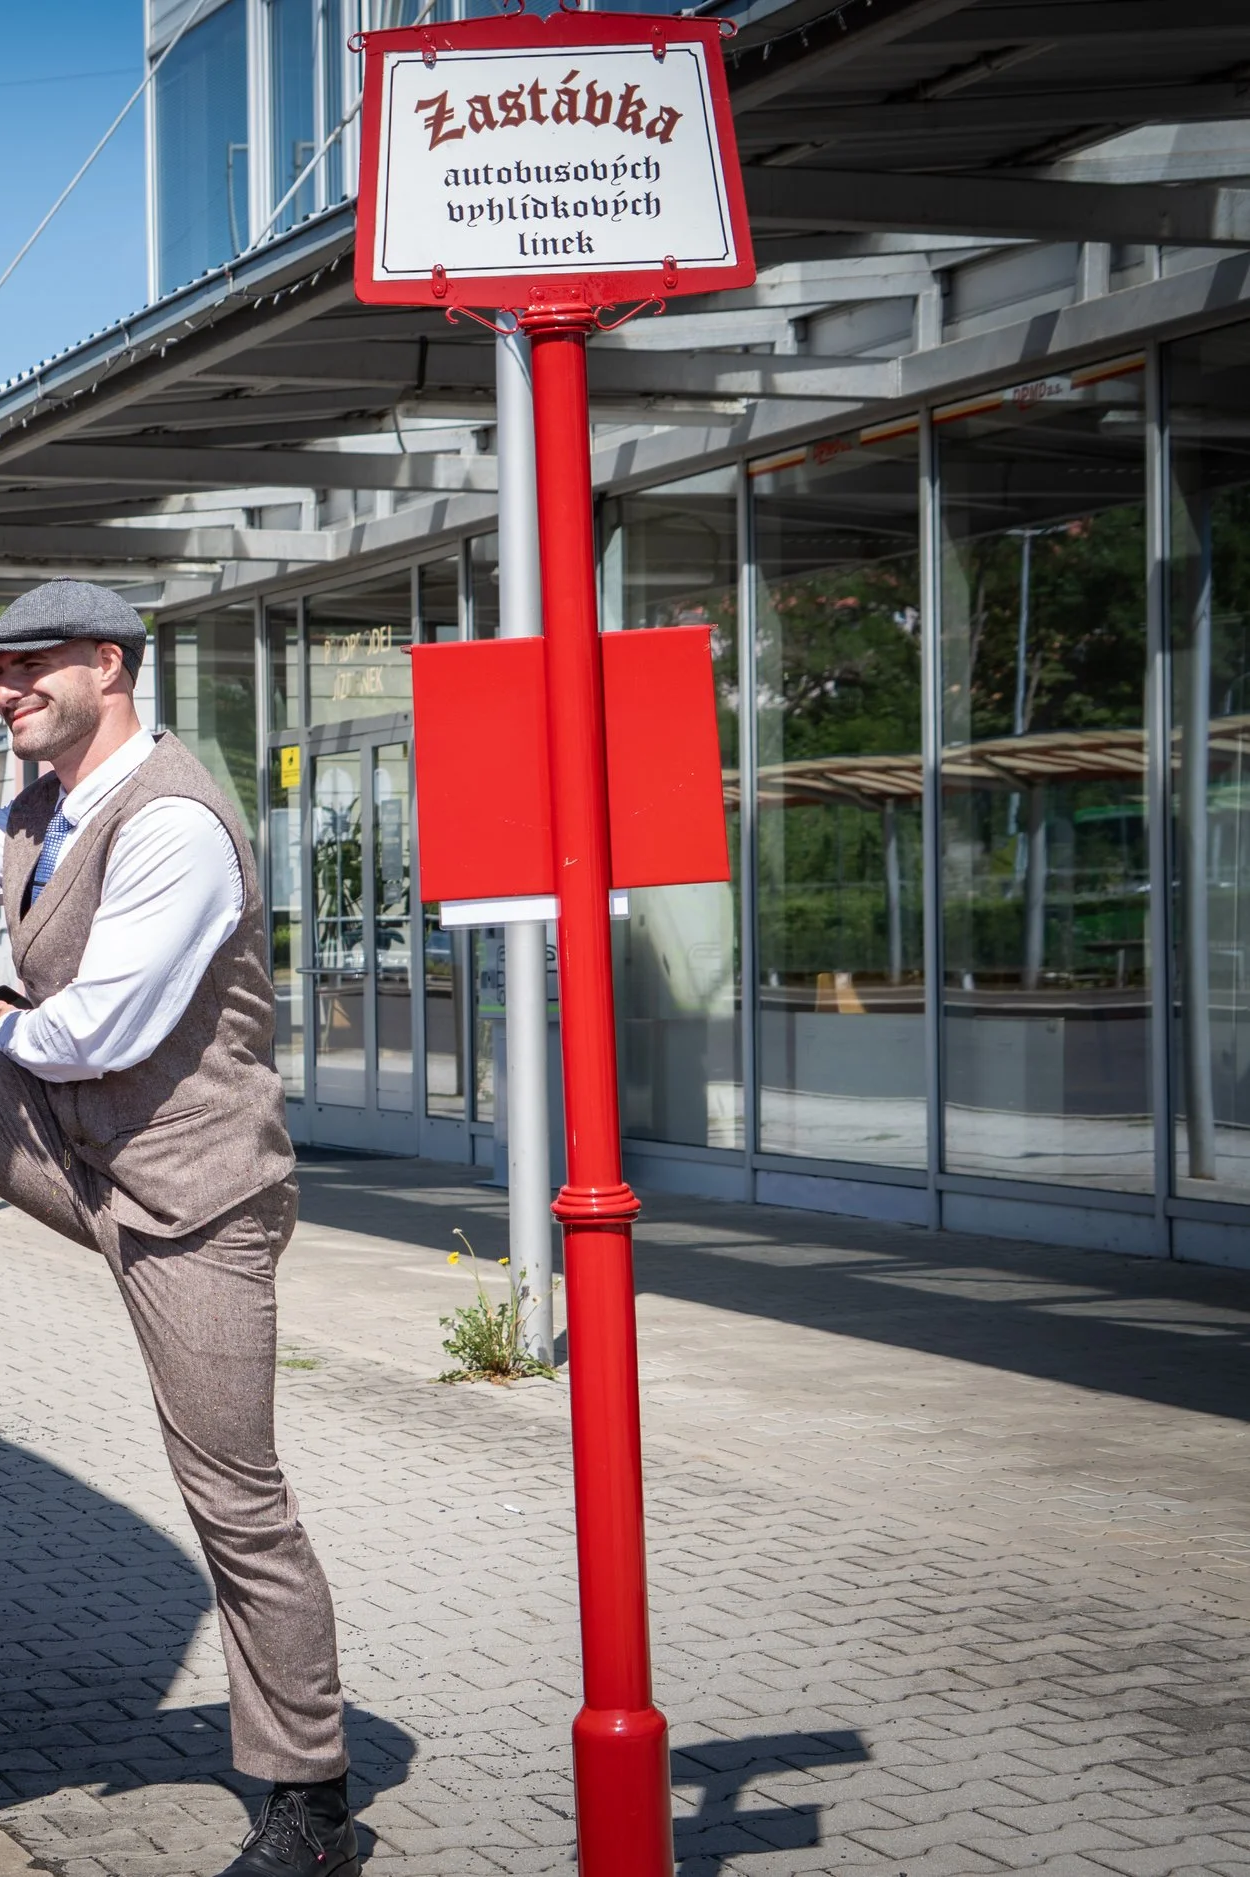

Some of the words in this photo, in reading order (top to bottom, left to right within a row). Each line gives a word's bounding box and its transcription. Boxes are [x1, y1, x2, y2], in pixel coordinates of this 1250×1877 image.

[414, 69, 684, 151] Zastávka
[443, 154, 661, 187] autobusových
[447, 191, 661, 228] vyhlídkových
[518, 231, 595, 257] linek
